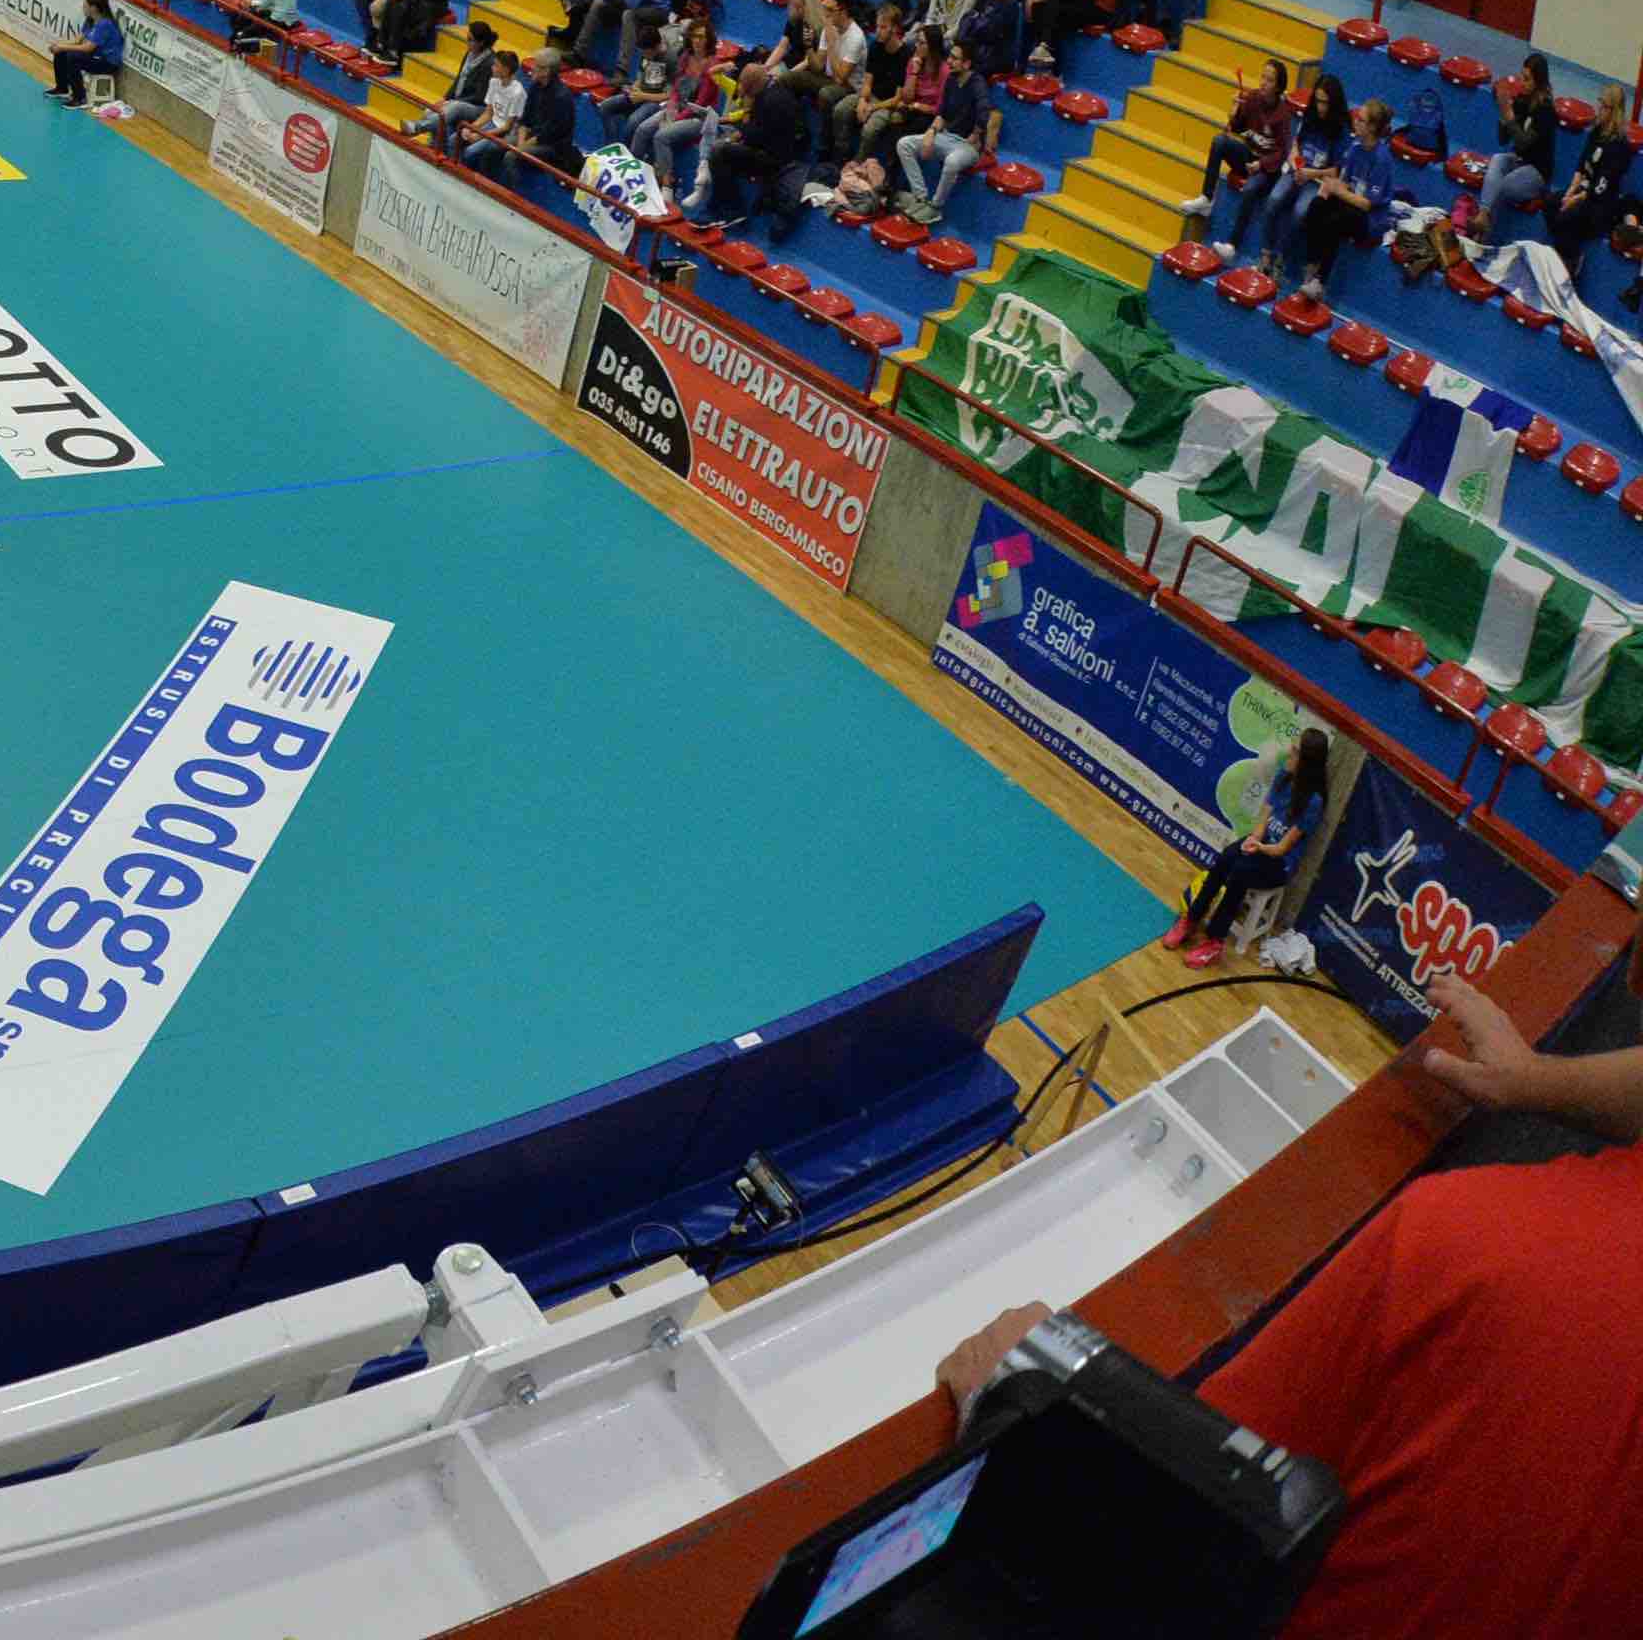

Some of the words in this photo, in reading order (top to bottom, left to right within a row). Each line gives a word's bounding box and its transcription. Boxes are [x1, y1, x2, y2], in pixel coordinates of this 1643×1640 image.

[587, 386, 615, 416] 035
[596, 345, 678, 420] Di&go
[641, 301, 884, 472] AUTORIPARAZIONI
[692, 400, 865, 536] ELETTRAUTO
[697, 461, 749, 508] CISANO
[749, 498, 846, 577] BERGAMASCO
[1032, 585, 1097, 641] grafica
[1043, 622, 1116, 684] salvioni
[134, 617, 231, 735] ESTRUSI
[94, 755, 131, 787] DI
[6, 701, 332, 1033] Bodega
